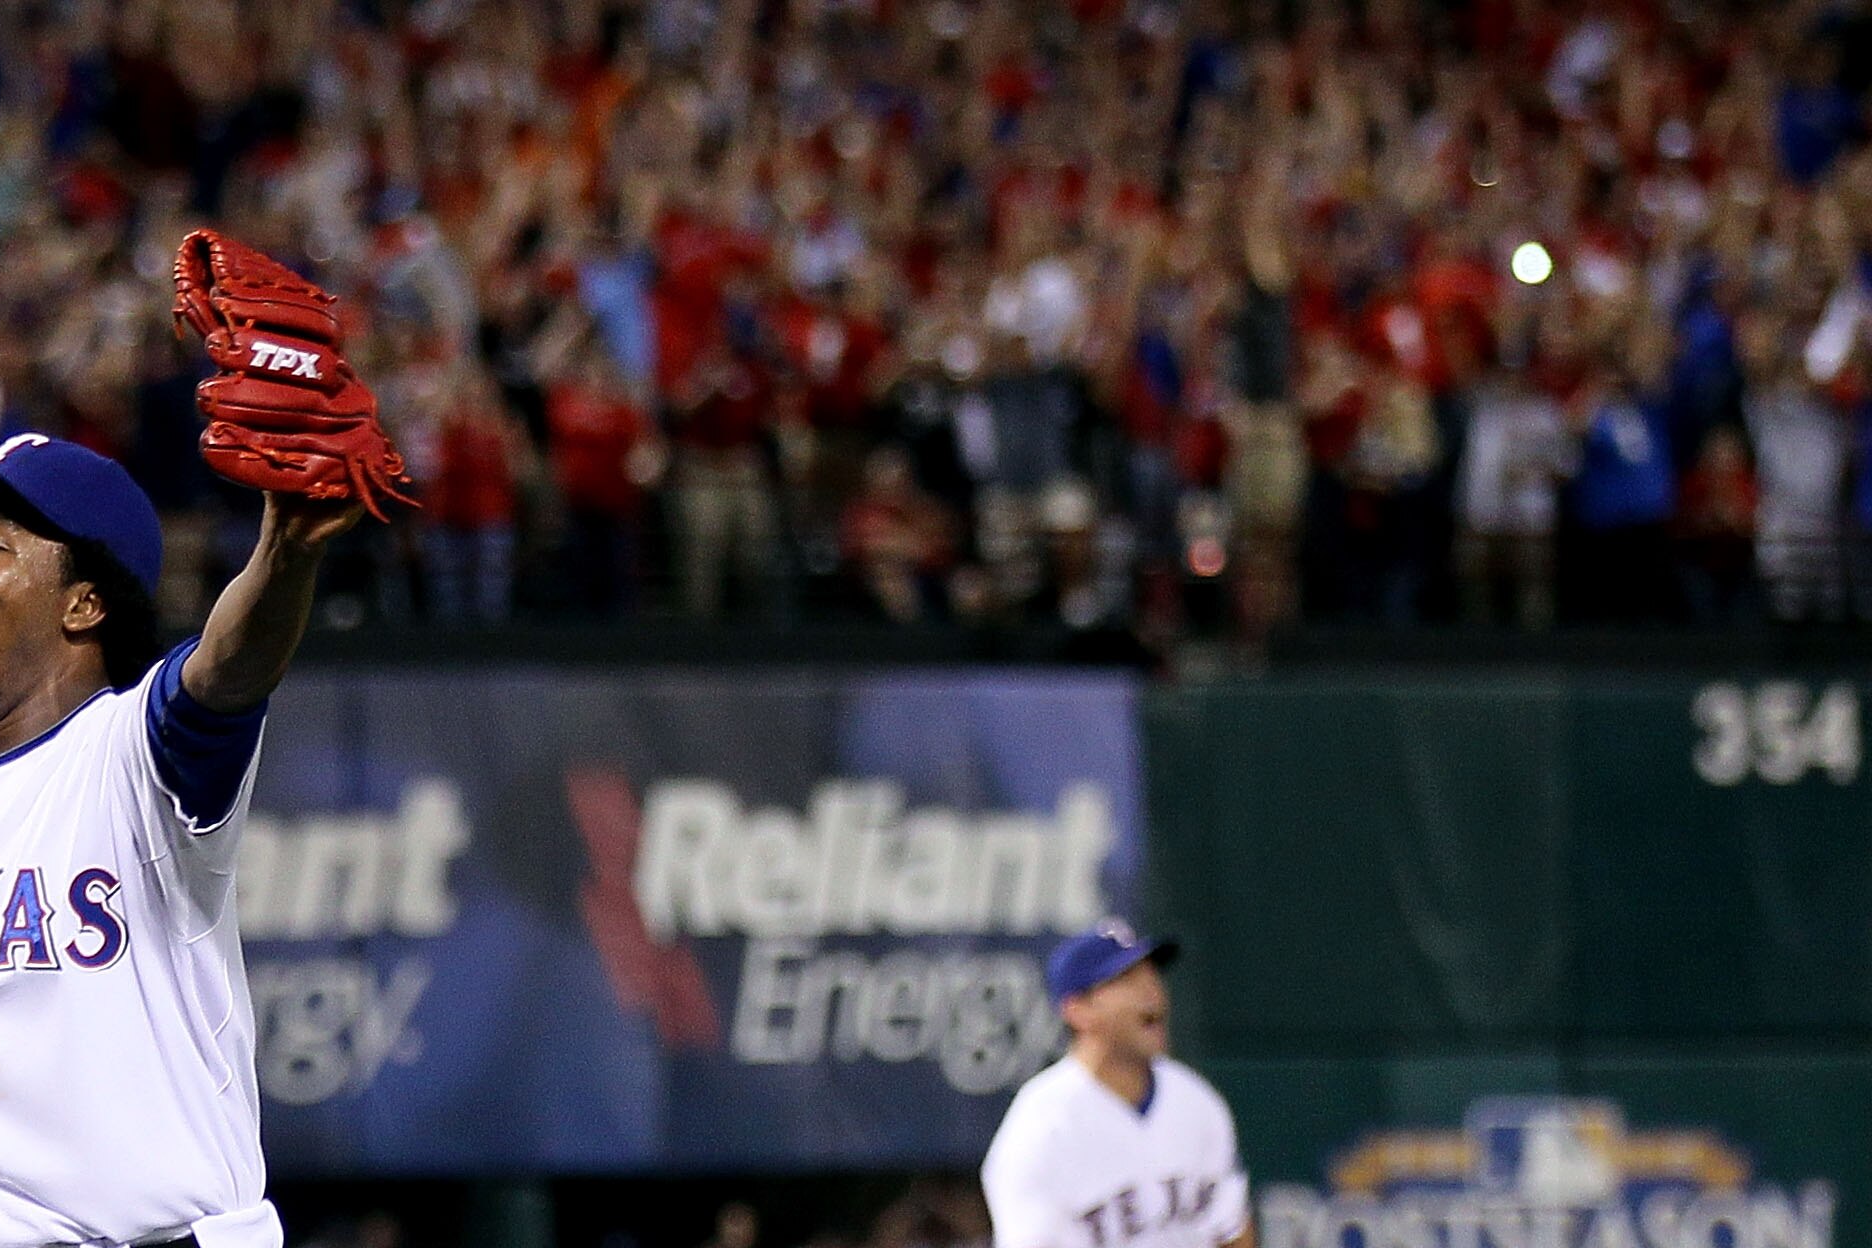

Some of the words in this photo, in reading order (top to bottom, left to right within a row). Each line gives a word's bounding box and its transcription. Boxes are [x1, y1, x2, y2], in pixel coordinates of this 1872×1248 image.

[249, 341, 321, 379] TPX
[1691, 682, 1861, 786] 354
[636, 778, 1113, 945] Reliant
